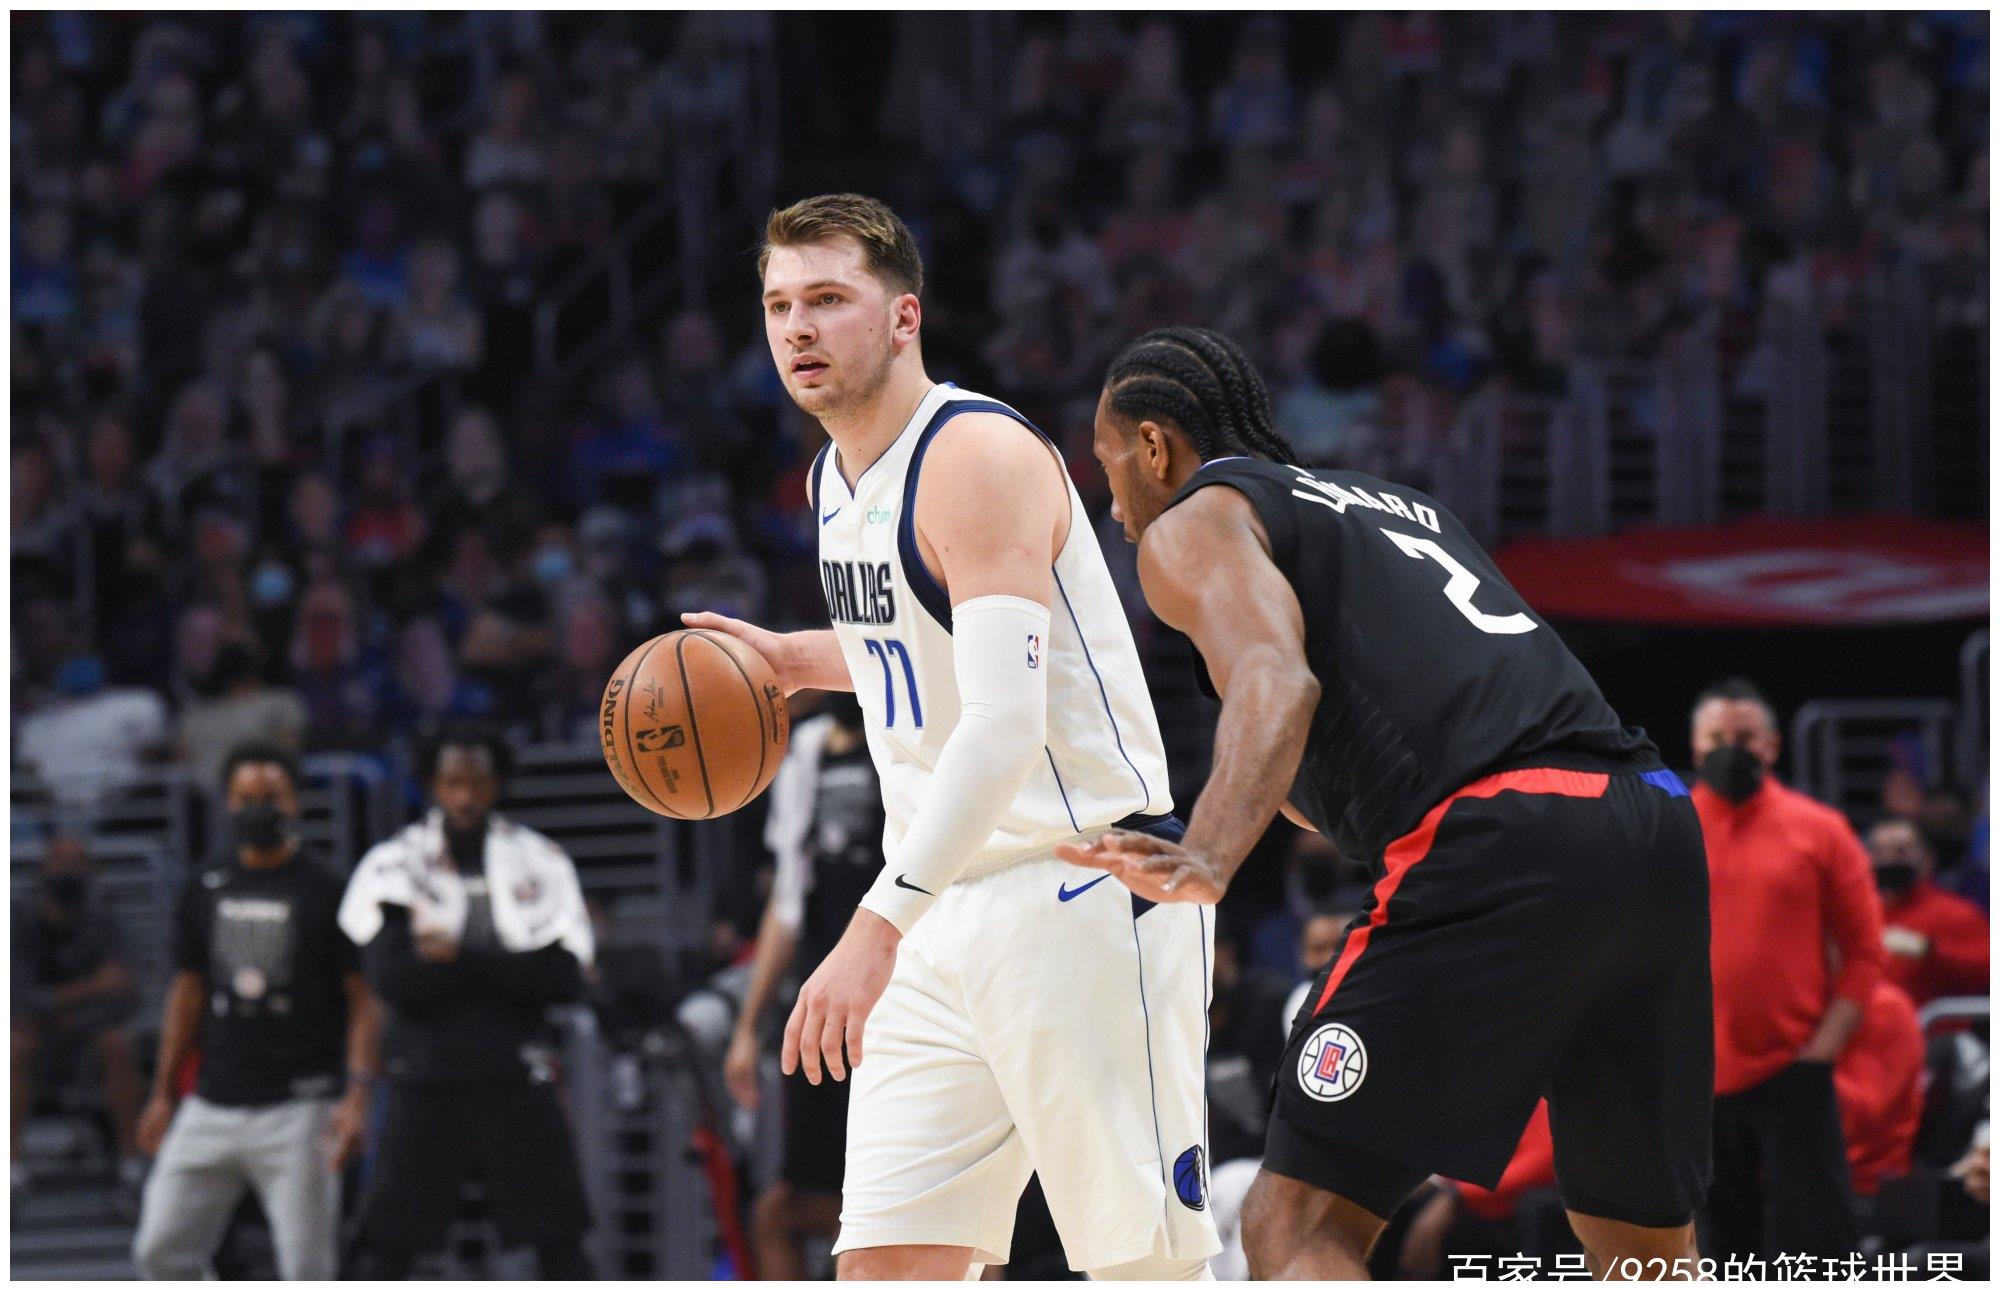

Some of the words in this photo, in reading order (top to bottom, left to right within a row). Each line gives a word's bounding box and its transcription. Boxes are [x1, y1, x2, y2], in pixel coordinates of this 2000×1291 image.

[866, 504, 892, 525] chim
[1291, 476, 1442, 534] LARD
[821, 558, 897, 627] DALLAS
[1380, 527, 1540, 634] 2
[864, 637, 924, 731] 77
